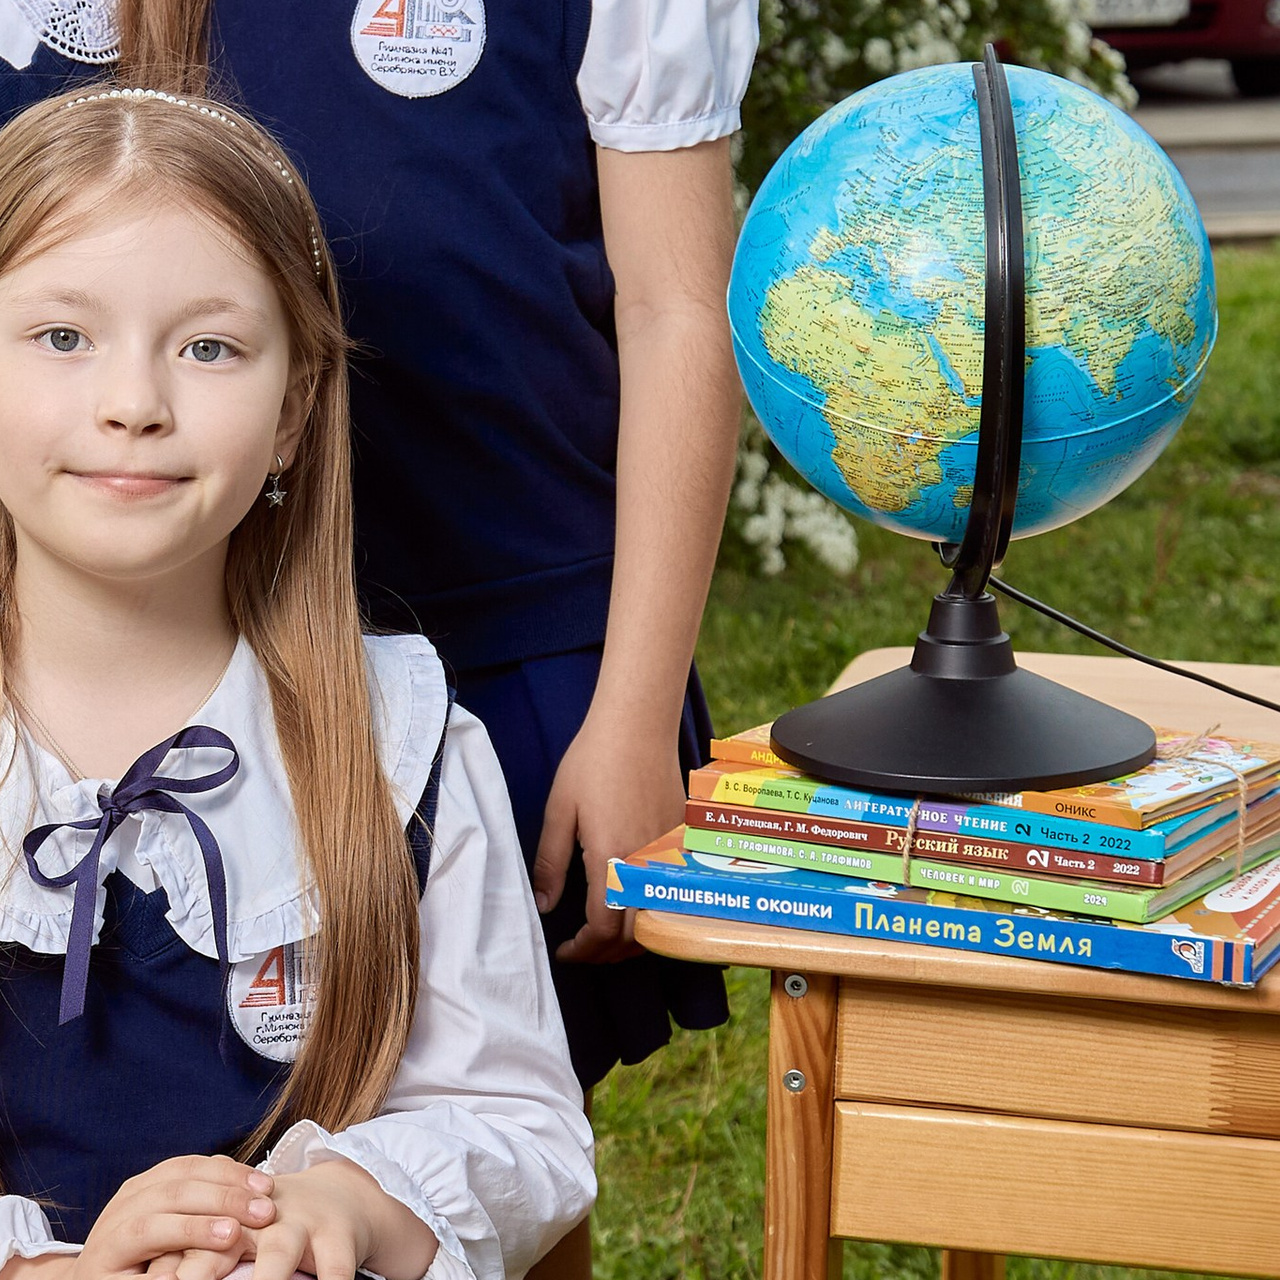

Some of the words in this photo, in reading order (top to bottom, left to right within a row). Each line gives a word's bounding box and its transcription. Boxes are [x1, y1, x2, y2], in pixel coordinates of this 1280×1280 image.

[378, 40, 428, 54] Гимназия
[750, 749, 789, 767] АНДР
[733, 782, 742, 792] С.
[743, 784, 785, 799] Воропаева,
[786, 790, 793, 799] Т.
[794, 791, 802, 801] С.
[803, 792, 839, 806] Куцанова
[843, 798, 948, 824] ЛИТЕРАТУНОЕ
[954, 813, 1008, 833] ЧТЕНИЕ
[1040, 826, 1078, 844] Часть
[1082, 832, 1091, 845] 2
[1099, 835, 1132, 851] 2022
[1055, 802, 1097, 819] ОНИКС
[705, 812, 716, 822] Е.
[717, 813, 729, 824] А.
[731, 815, 783, 832] Гулецкая,
[784, 821, 794, 832] Г.
[796, 823, 809, 834] М.
[810, 825, 869, 841] Федорович
[715, 836, 725, 847] Г.
[726, 838, 735, 848] В.
[798, 849, 808, 860] С.
[809, 851, 819, 862] А.
[821, 852, 872, 870] ТРАФИМОВ
[963, 844, 1009, 861] язык
[1053, 855, 1087, 870] Часть
[1087, 859, 1096, 870] 2
[1113, 862, 1140, 875] 2022
[920, 867, 966, 885] ЧЕЛОВЕК
[968, 874, 976, 886] И
[978, 876, 1001, 889] МИР
[1083, 893, 1108, 907] 2024
[644, 883, 751, 910] ВОЛШЕБНЫЕ
[756, 897, 834, 920] ОКОШКИ
[855, 901, 982, 944] Планета
[993, 918, 1093, 959] Земля
